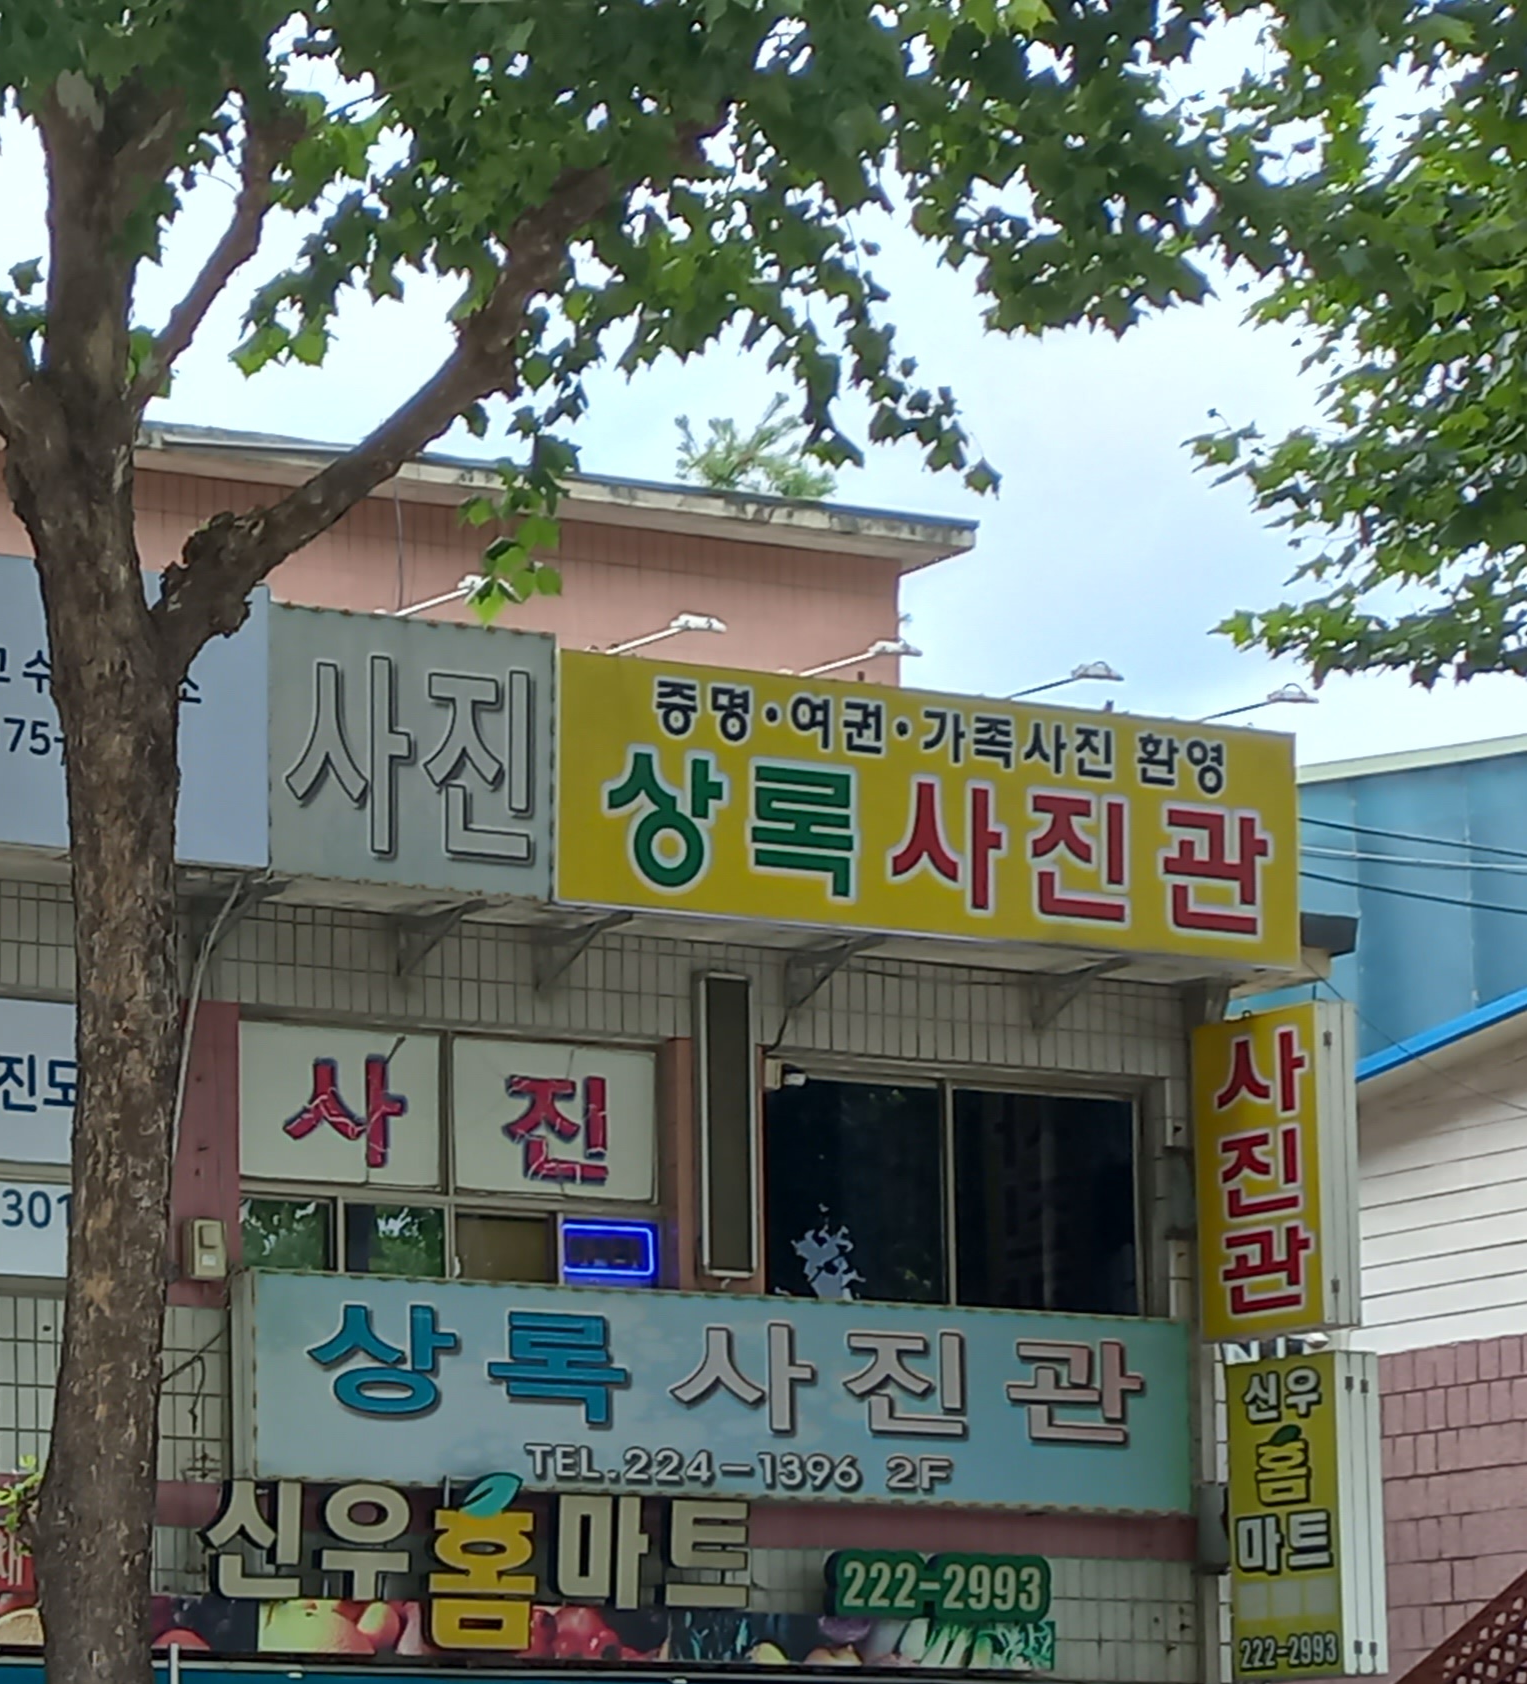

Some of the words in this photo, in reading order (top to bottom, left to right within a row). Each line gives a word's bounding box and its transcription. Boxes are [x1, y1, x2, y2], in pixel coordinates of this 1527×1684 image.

[286, 656, 533, 862] 사진
[1138, 731, 1225, 792] 환영
[606, 745, 857, 899] 상록
[890, 782, 1269, 936] 사진관
[1216, 1029, 1312, 1316] 사진관
[308, 1301, 628, 1427] 상록
[670, 1320, 1145, 1446] 사진관
[1242, 1369, 1322, 1421] 신우
[886, 1456, 952, 1493] 2F
[1255, 1442, 1308, 1504] 홈
[1235, 1509, 1332, 1575] 마트
[841, 1557, 1043, 1613] 222-2993
[1239, 1631, 1337, 1672] 222-2993
